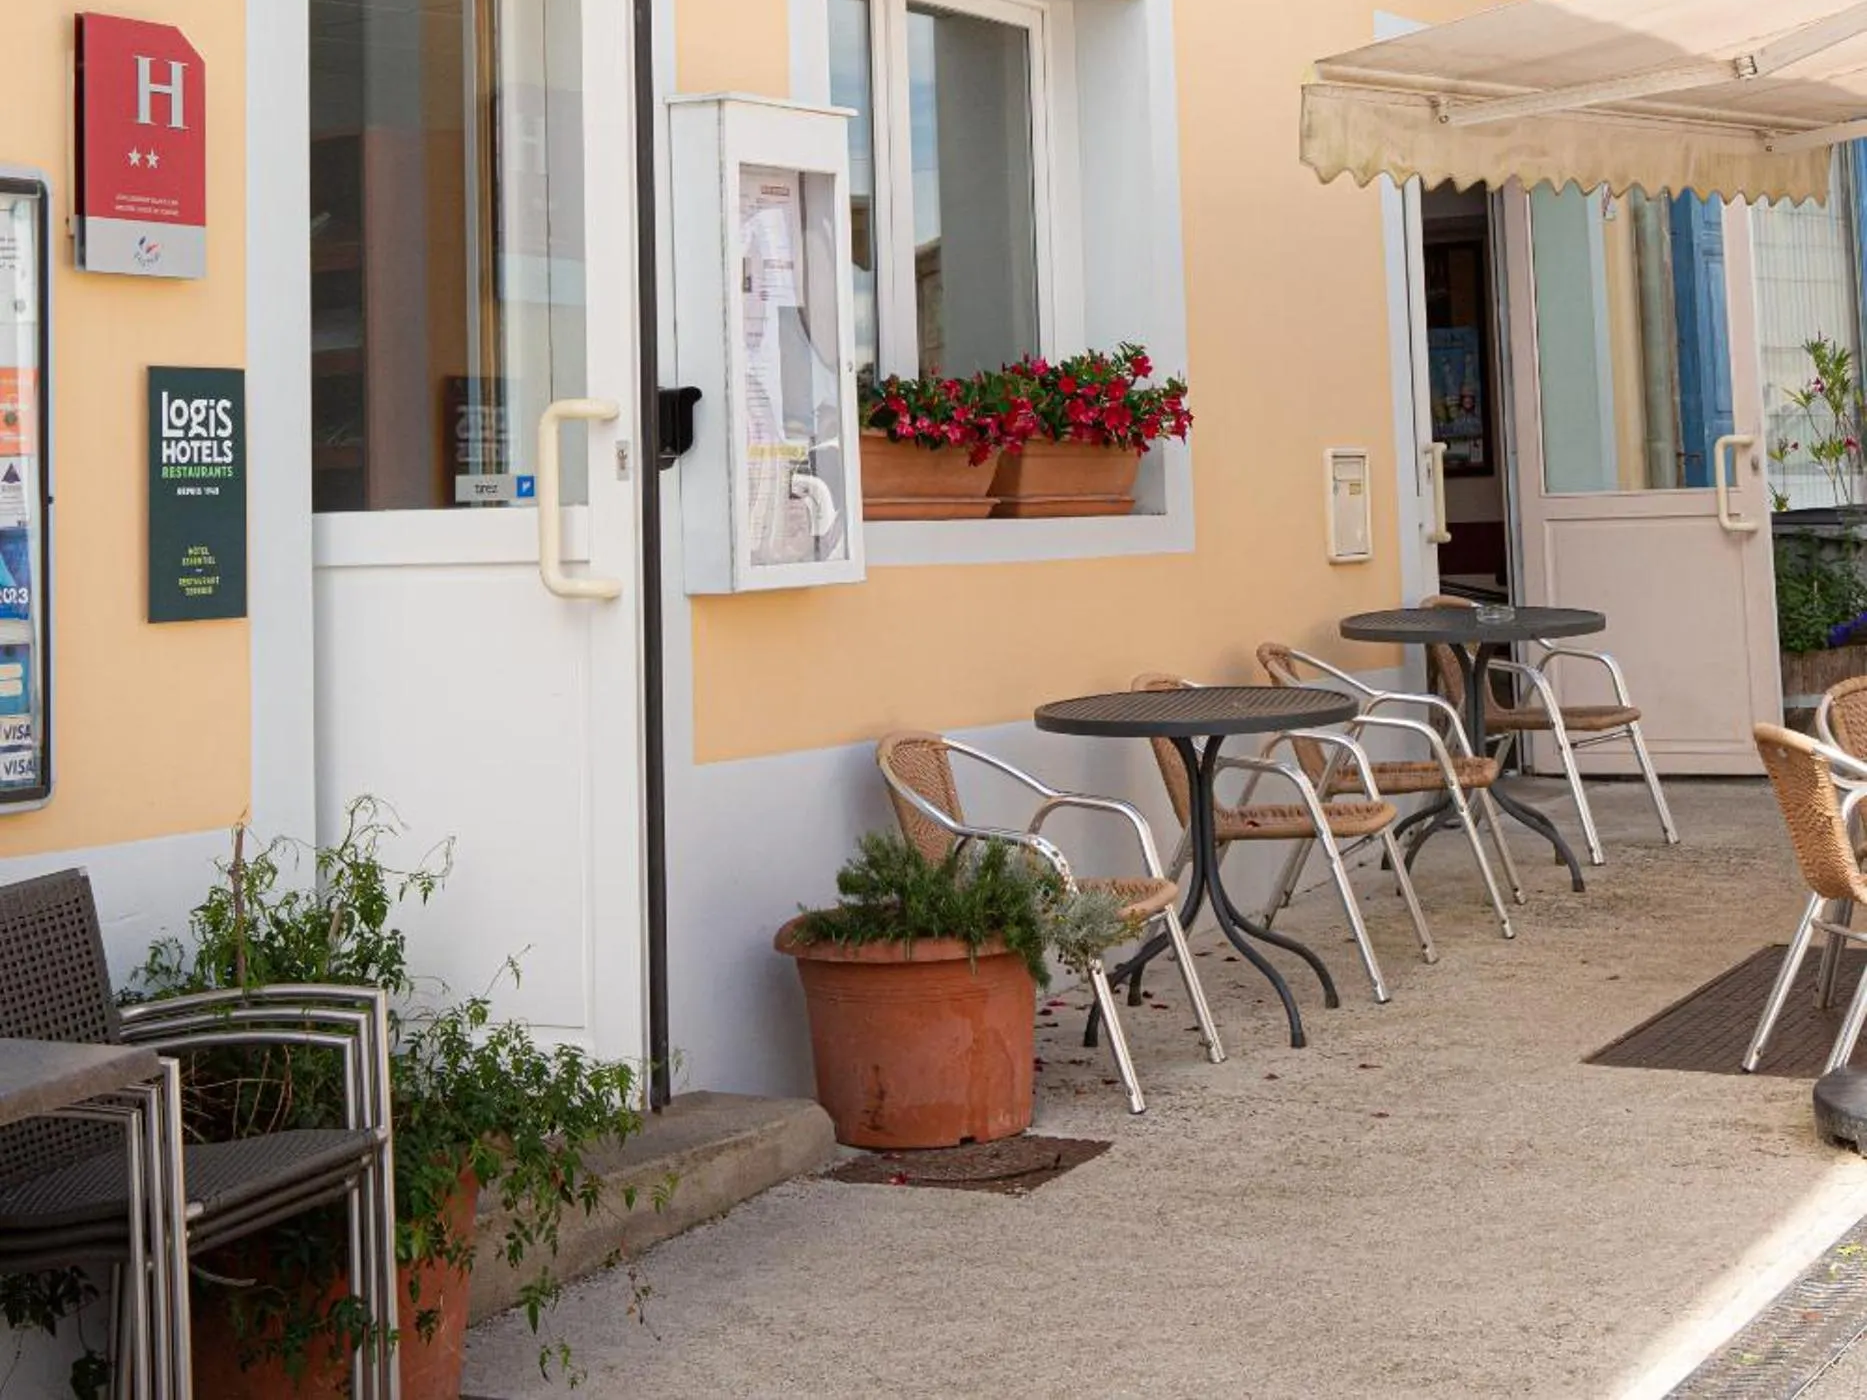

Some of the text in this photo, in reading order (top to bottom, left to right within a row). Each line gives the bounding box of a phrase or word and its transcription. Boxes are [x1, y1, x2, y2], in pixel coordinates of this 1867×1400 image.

[133, 55, 190, 131] H
[161, 439, 234, 465] HOTELS
[161, 465, 234, 479] RESTAURANTS
